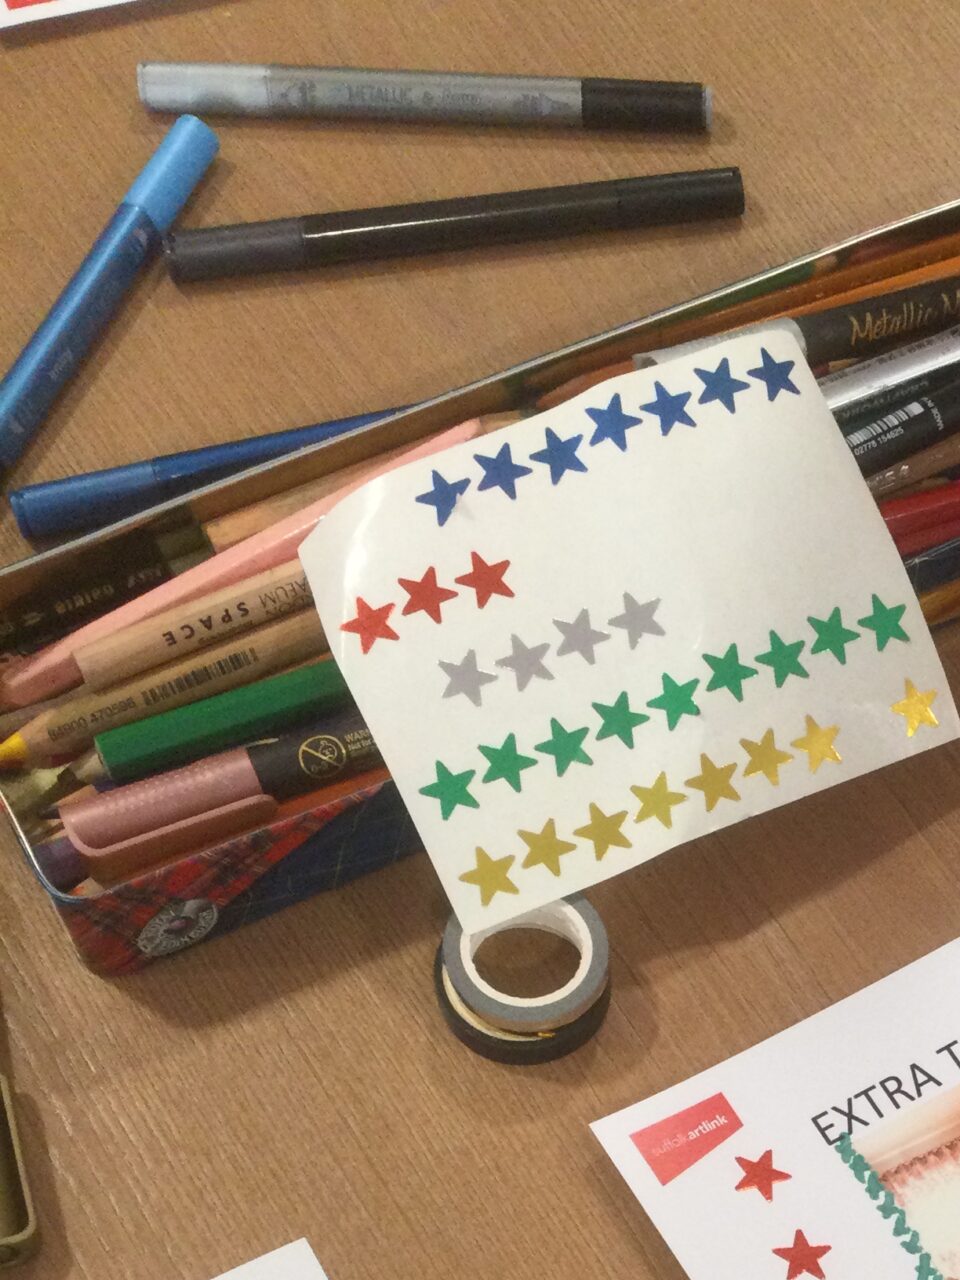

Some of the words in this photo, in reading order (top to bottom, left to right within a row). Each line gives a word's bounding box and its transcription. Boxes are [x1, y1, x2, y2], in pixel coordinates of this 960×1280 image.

[848, 302, 938, 347] Metallic
[160, 600, 251, 648] SPACE
[807, 1061, 944, 1148] EXTRA
